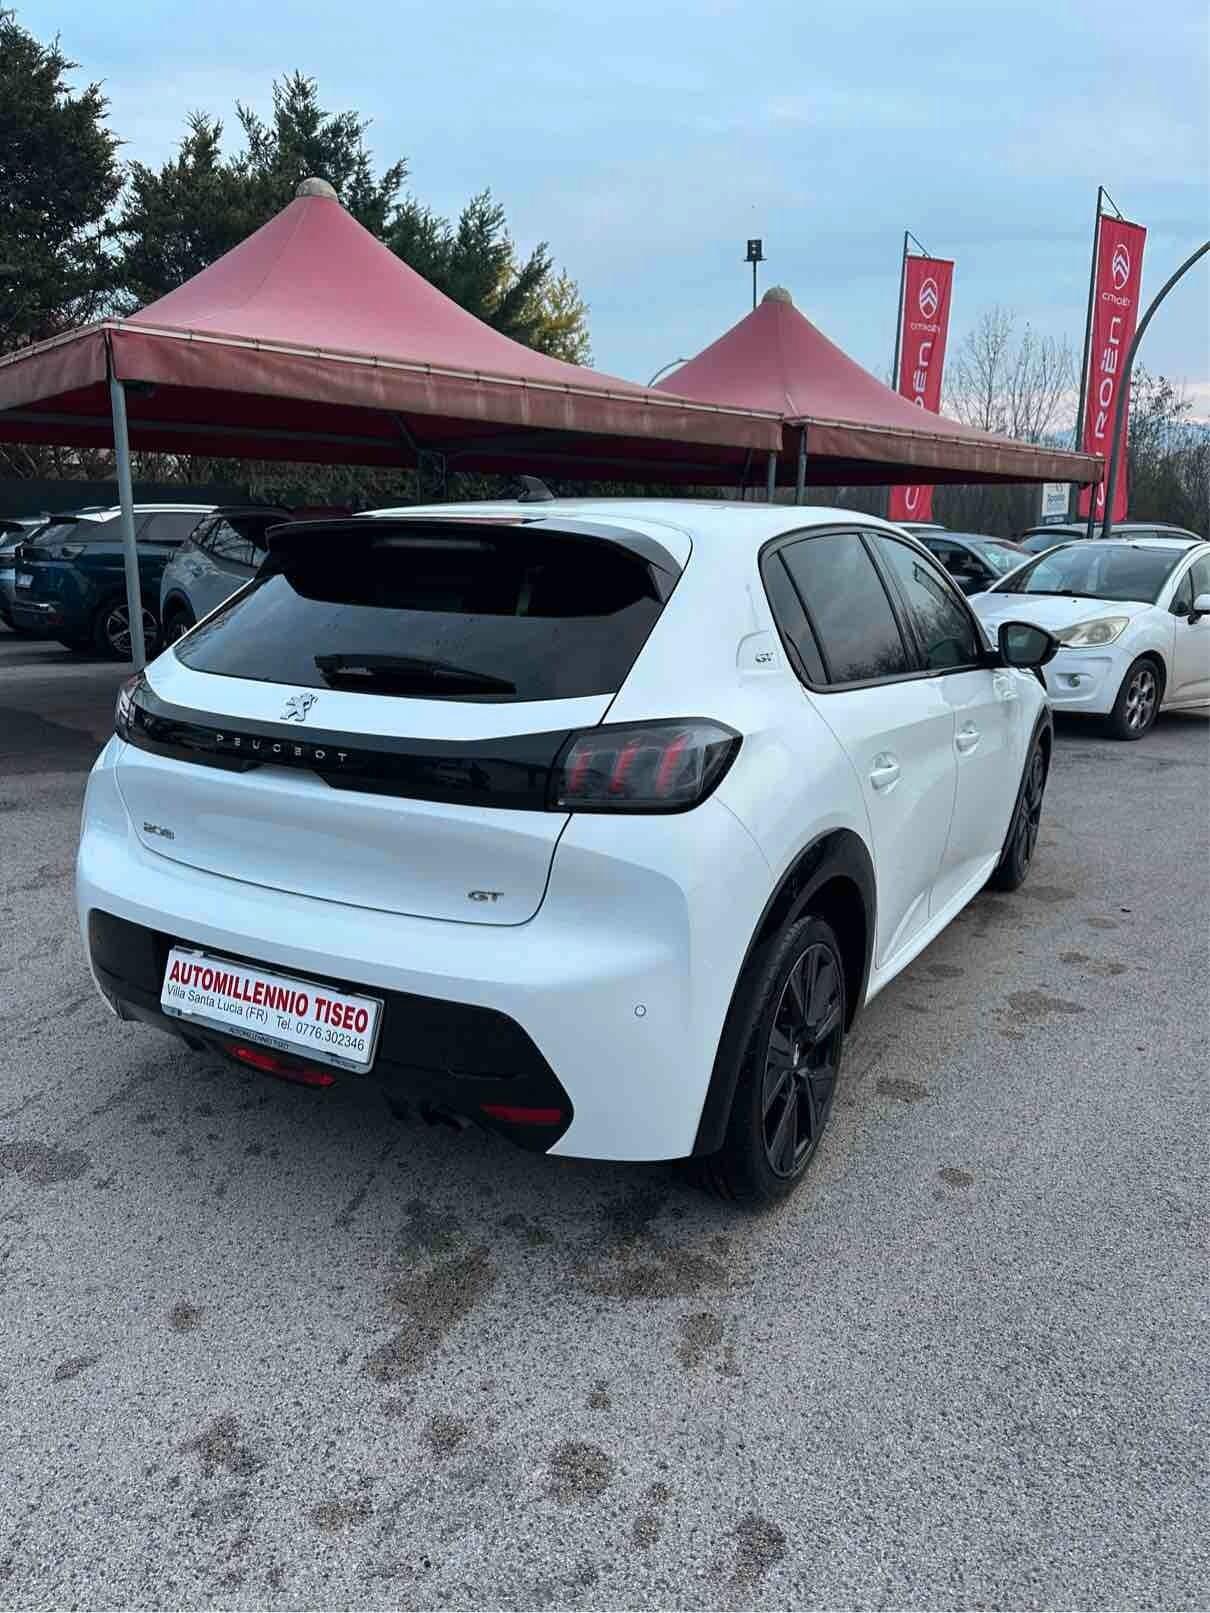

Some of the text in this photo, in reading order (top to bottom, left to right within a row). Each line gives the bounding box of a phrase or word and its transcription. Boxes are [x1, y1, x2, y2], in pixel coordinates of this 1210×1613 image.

[215, 733, 348, 763] PEUGEOT
[467, 890, 504, 903] GT
[166, 984, 366, 1051] Villa Santa Lucia (FR) Tel. 0776.302346
[169, 959, 369, 1034] AUTOMILLENNIO TISEO
